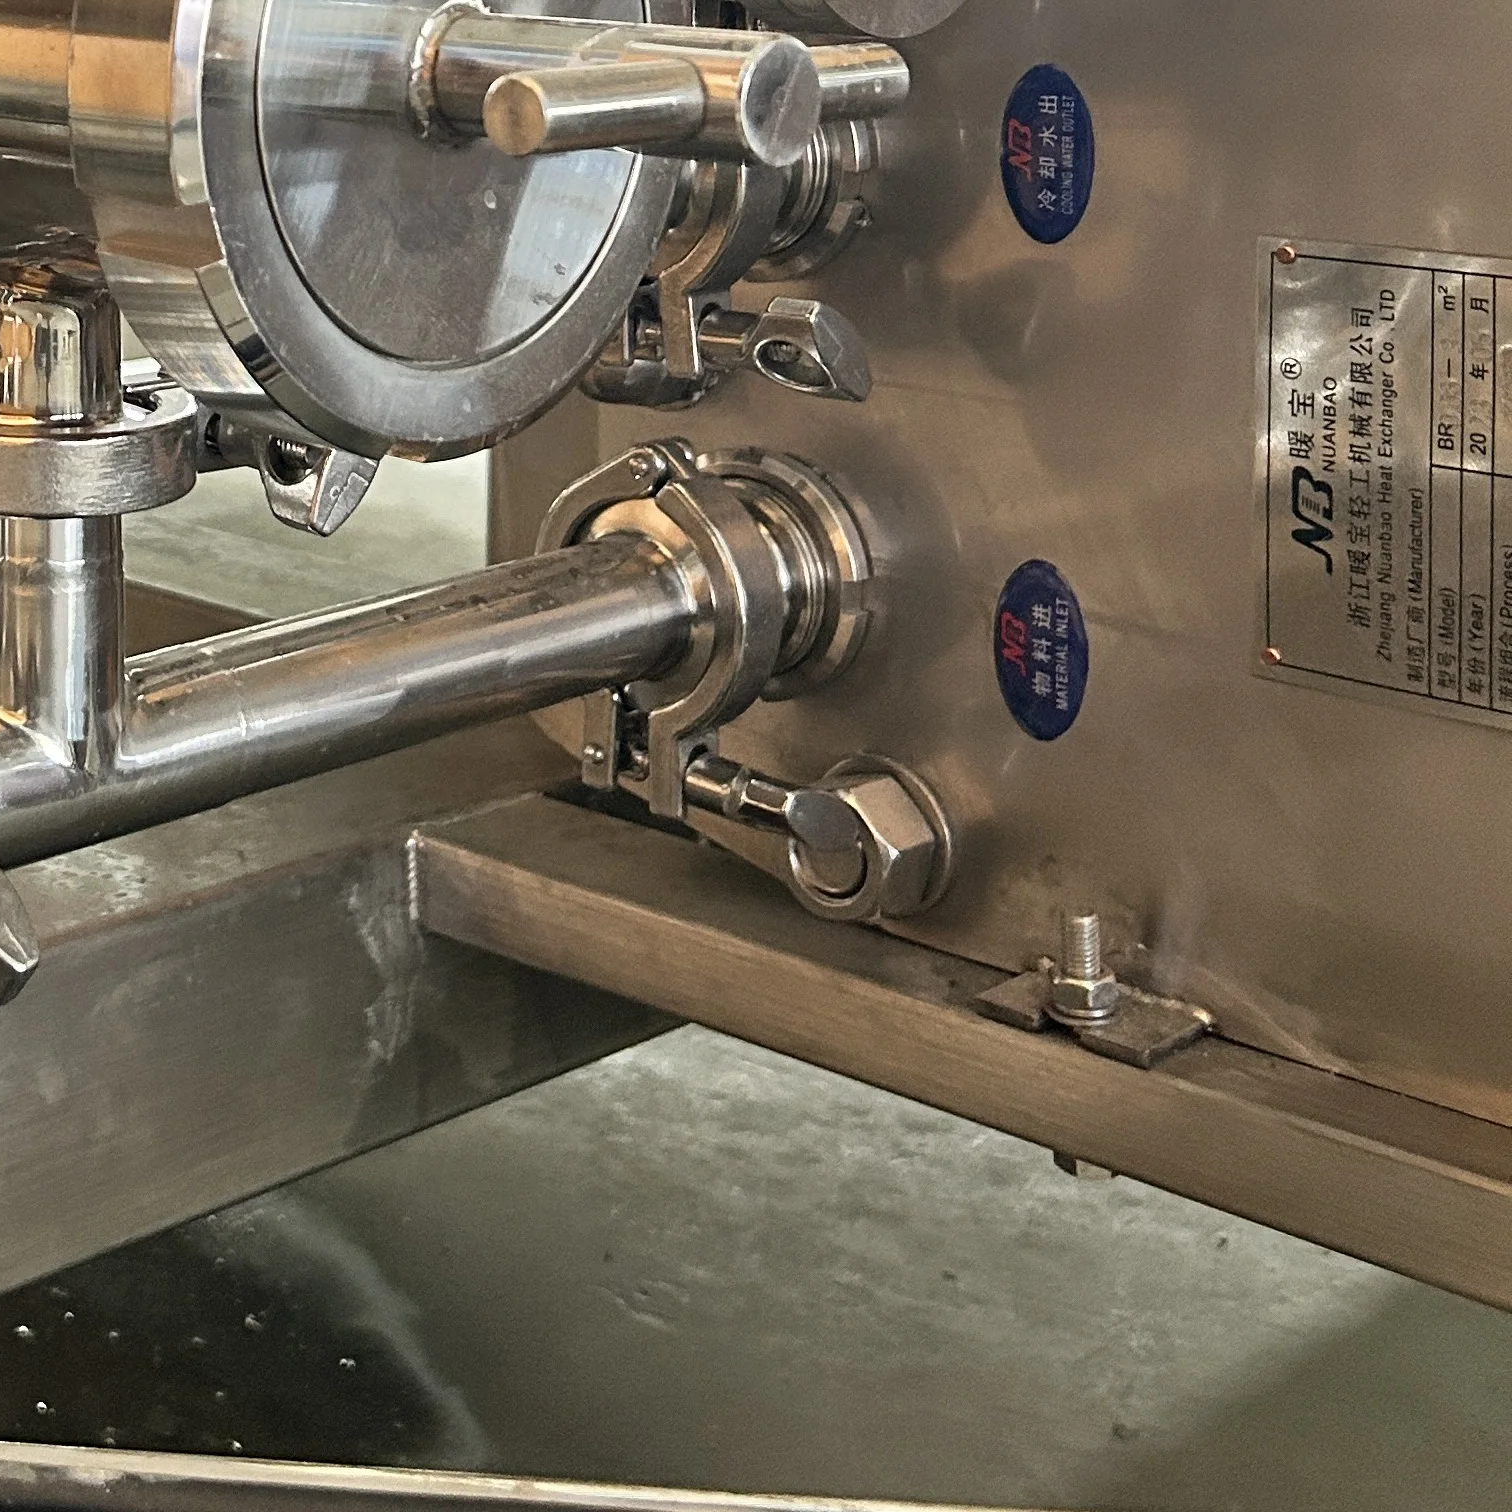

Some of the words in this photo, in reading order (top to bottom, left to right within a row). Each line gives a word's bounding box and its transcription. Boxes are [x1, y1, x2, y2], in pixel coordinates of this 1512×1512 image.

[1061, 94, 1077, 133] OUTLET
[1037, 94, 1059, 212] 冷却水出
[1061, 135, 1075, 168] WATER
[1060, 171, 1075, 216] COOLING
[1321, 375, 1338, 474] NUANBAO
[1378, 371, 1398, 458] Exchanger
[1346, 307, 1375, 629] 浙江暖宝轻工机械有限公司
[1377, 464, 1393, 504] Heat
[1376, 511, 1393, 585] Nuanbao
[1031, 603, 1052, 697] 物料进
[1055, 597, 1070, 640] INLET
[1376, 590, 1396, 663] Zhejiang
[1055, 642, 1069, 712] MATERIAL
